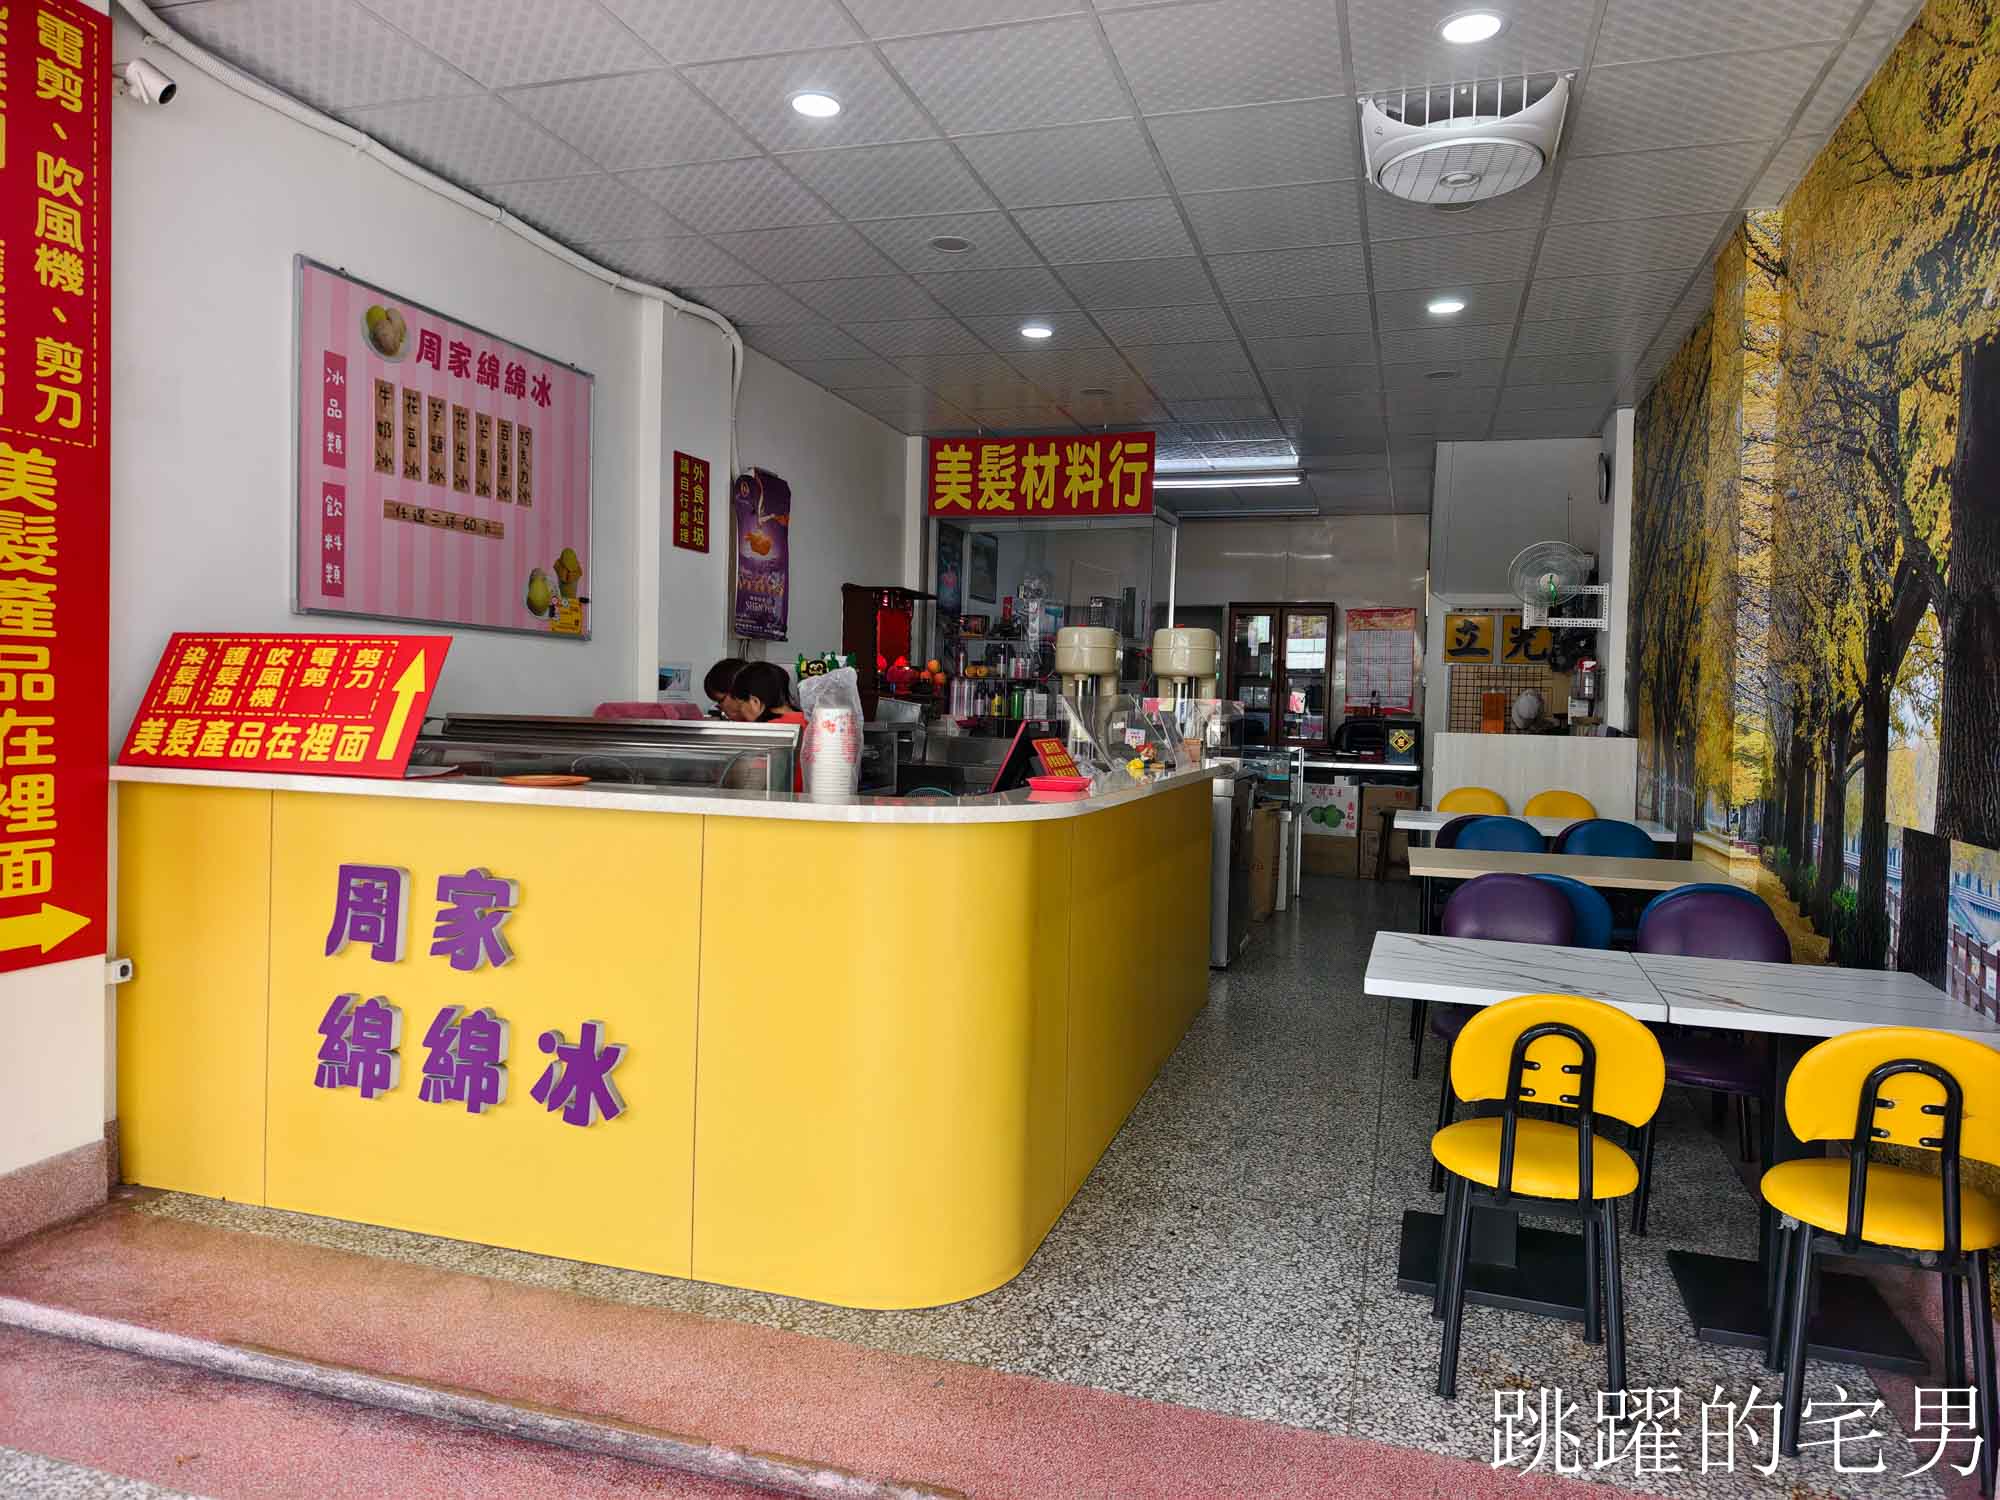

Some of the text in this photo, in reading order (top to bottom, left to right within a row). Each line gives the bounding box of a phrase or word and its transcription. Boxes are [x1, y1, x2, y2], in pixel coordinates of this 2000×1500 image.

[35, 10, 85, 430] 電剪、吹風機、剪刀
[416, 328, 552, 408] 周家綿綿冰
[325, 366, 345, 455] 冰品類
[375, 385, 393, 468] 牛奶冰
[455, 411, 470, 489] 花生冰
[692, 463, 705, 547] 外食垃圾
[933, 440, 1149, 511] 美髮材料行
[324, 494, 343, 586] 飲料類
[163, 646, 209, 705] 染髮劑
[205, 646, 251, 707] 護髮油
[248, 647, 294, 708] 吹風機
[300, 647, 338, 688] 電剪
[345, 648, 384, 689] 剪刀
[129, 718, 376, 762] 美髮產品在裡面
[325, 863, 517, 972] 周家
[314, 993, 628, 1127] 綿綿冰
